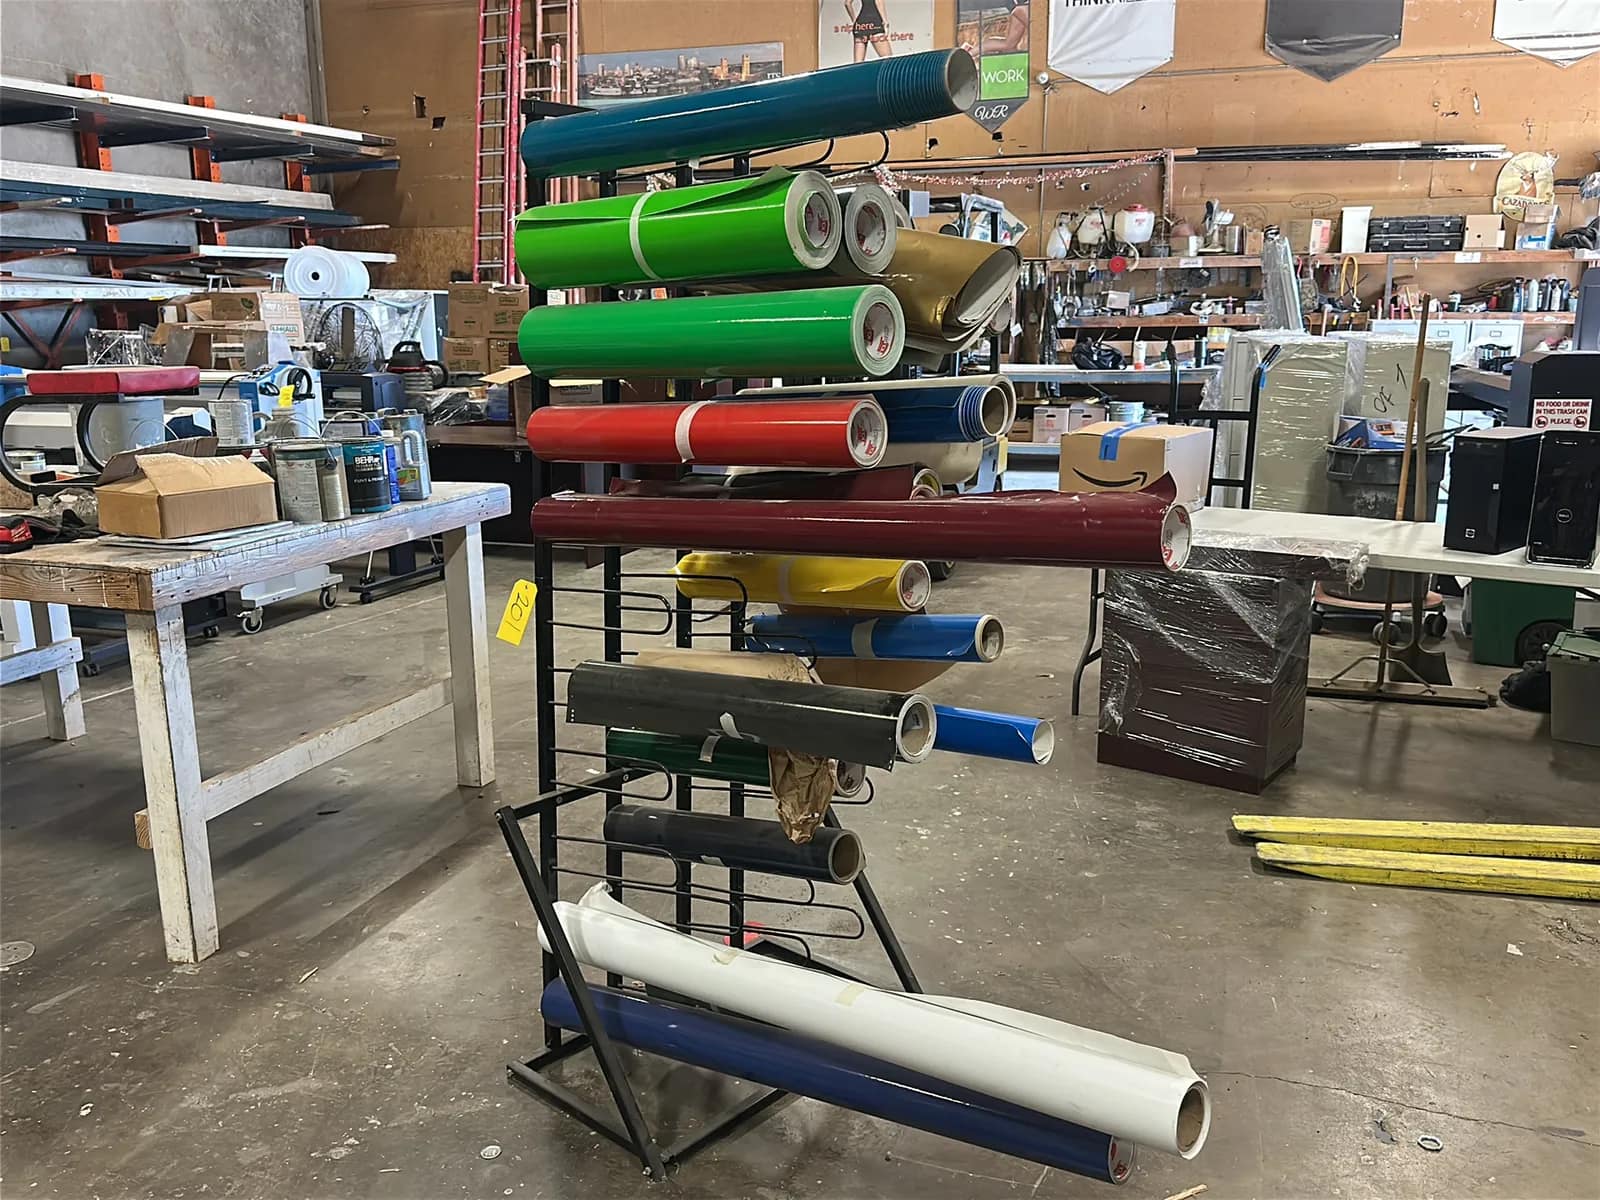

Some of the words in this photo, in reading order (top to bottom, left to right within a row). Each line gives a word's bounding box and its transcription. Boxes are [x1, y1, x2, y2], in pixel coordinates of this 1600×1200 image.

[890, 32, 914, 41] there
[982, 69, 1025, 83] WORK
[354, 455, 374, 465] BEHR
